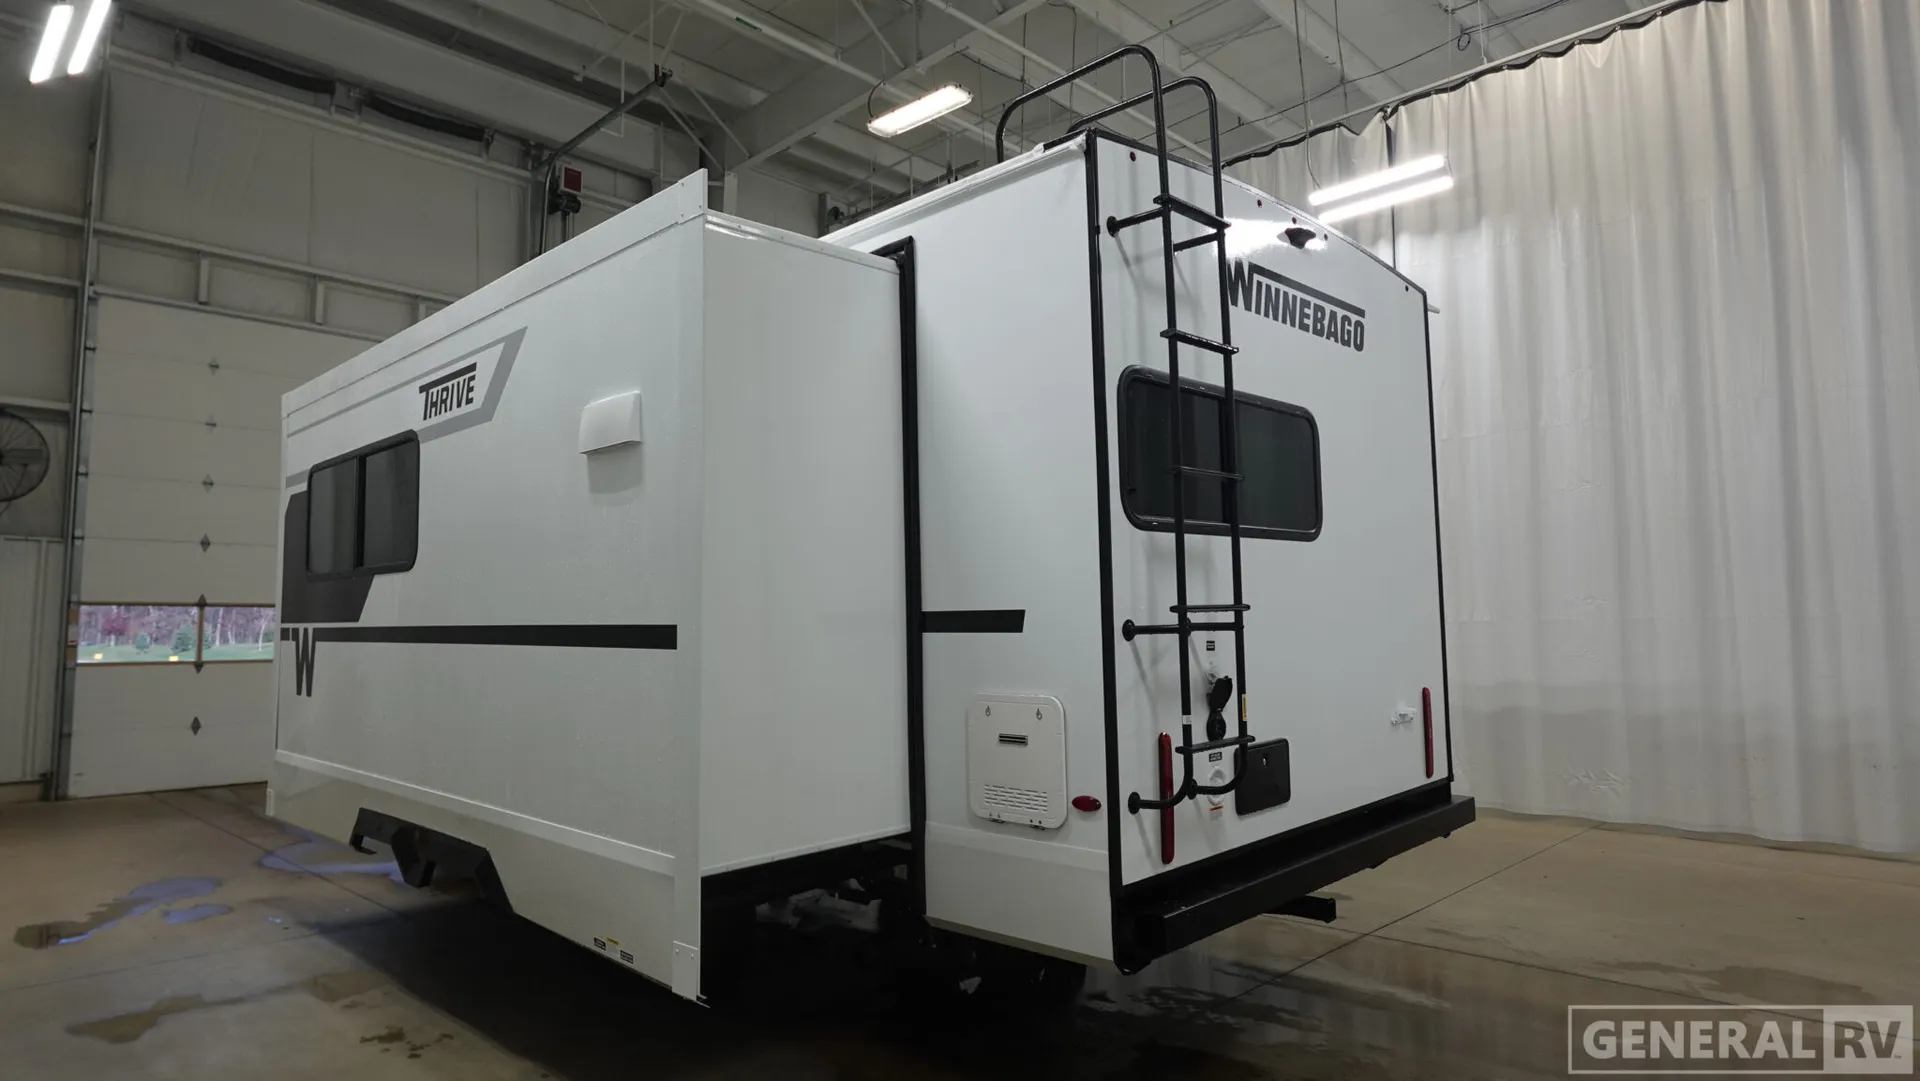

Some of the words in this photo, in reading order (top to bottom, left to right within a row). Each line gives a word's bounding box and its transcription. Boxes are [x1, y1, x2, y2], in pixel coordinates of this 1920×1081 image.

[1227, 258, 1366, 352] WINNEBAGO
[418, 361, 478, 421] THRIVE
[292, 627, 317, 697] W
